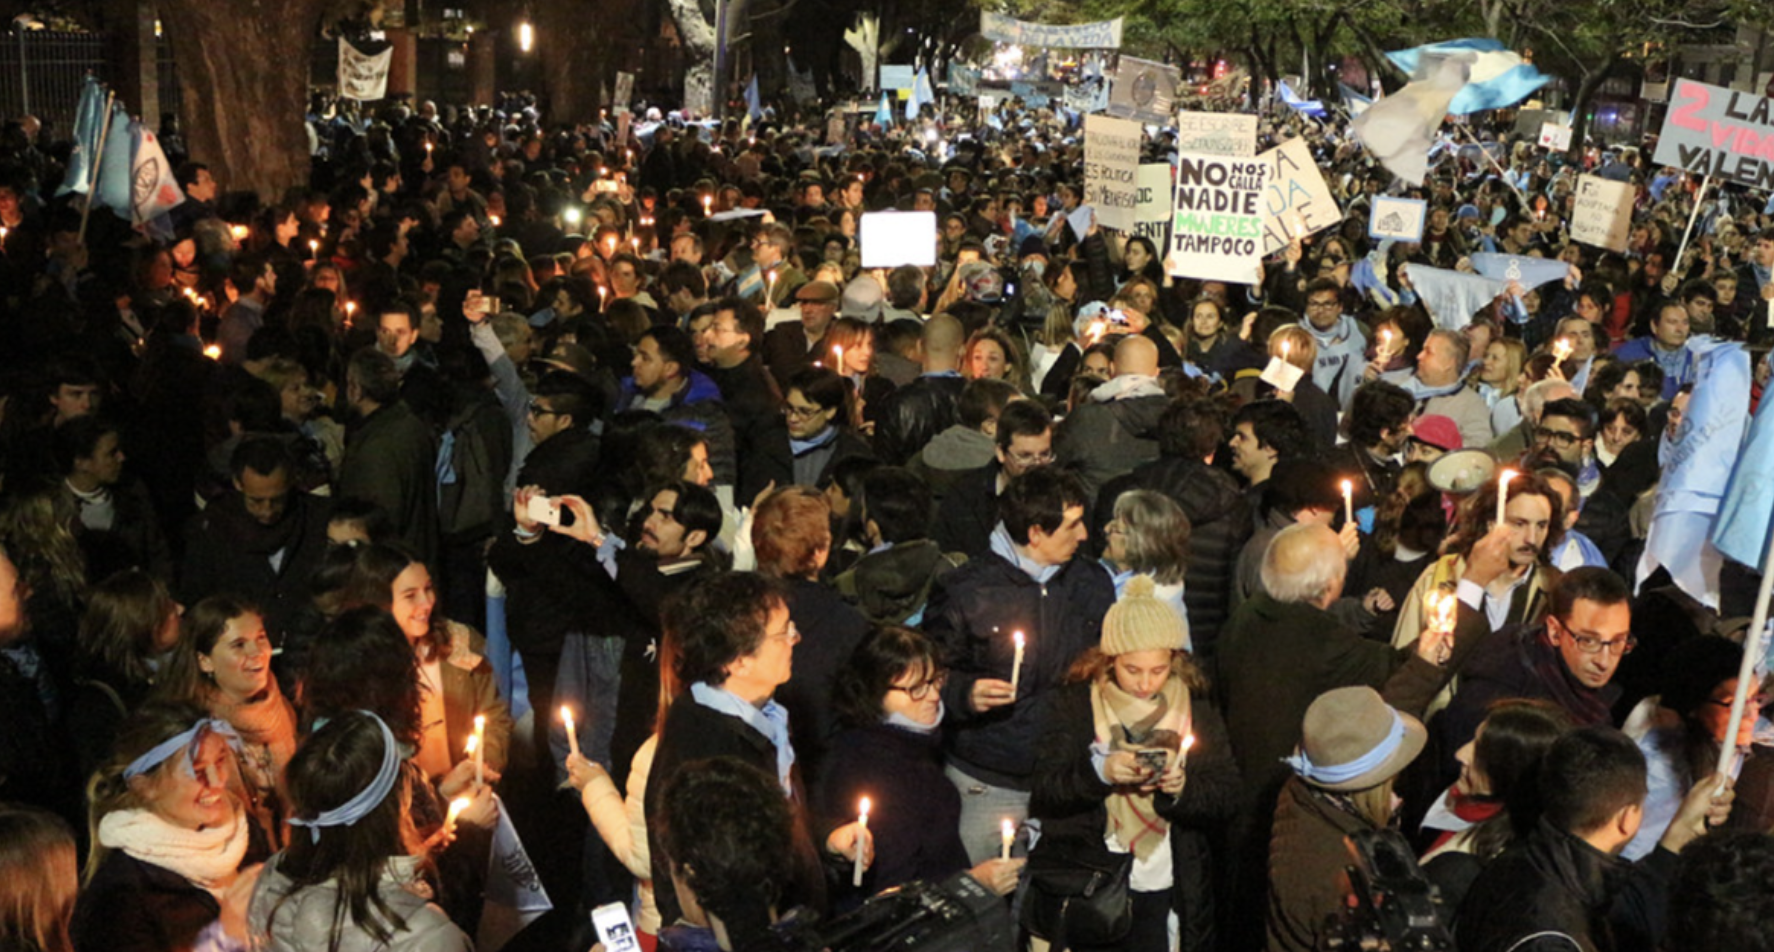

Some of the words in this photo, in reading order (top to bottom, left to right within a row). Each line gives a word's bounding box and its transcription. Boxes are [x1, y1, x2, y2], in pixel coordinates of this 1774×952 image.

[1670, 82, 1711, 133] 2
[1725, 91, 1774, 126] LA
[1180, 158, 1228, 187] NO
[1231, 162, 1266, 177] NOS
[1228, 175, 1263, 191] CALLA
[1178, 187, 1259, 215] NADIE
[1175, 212, 1262, 238] MUJERES
[1175, 233, 1255, 256] TAMPOCO
